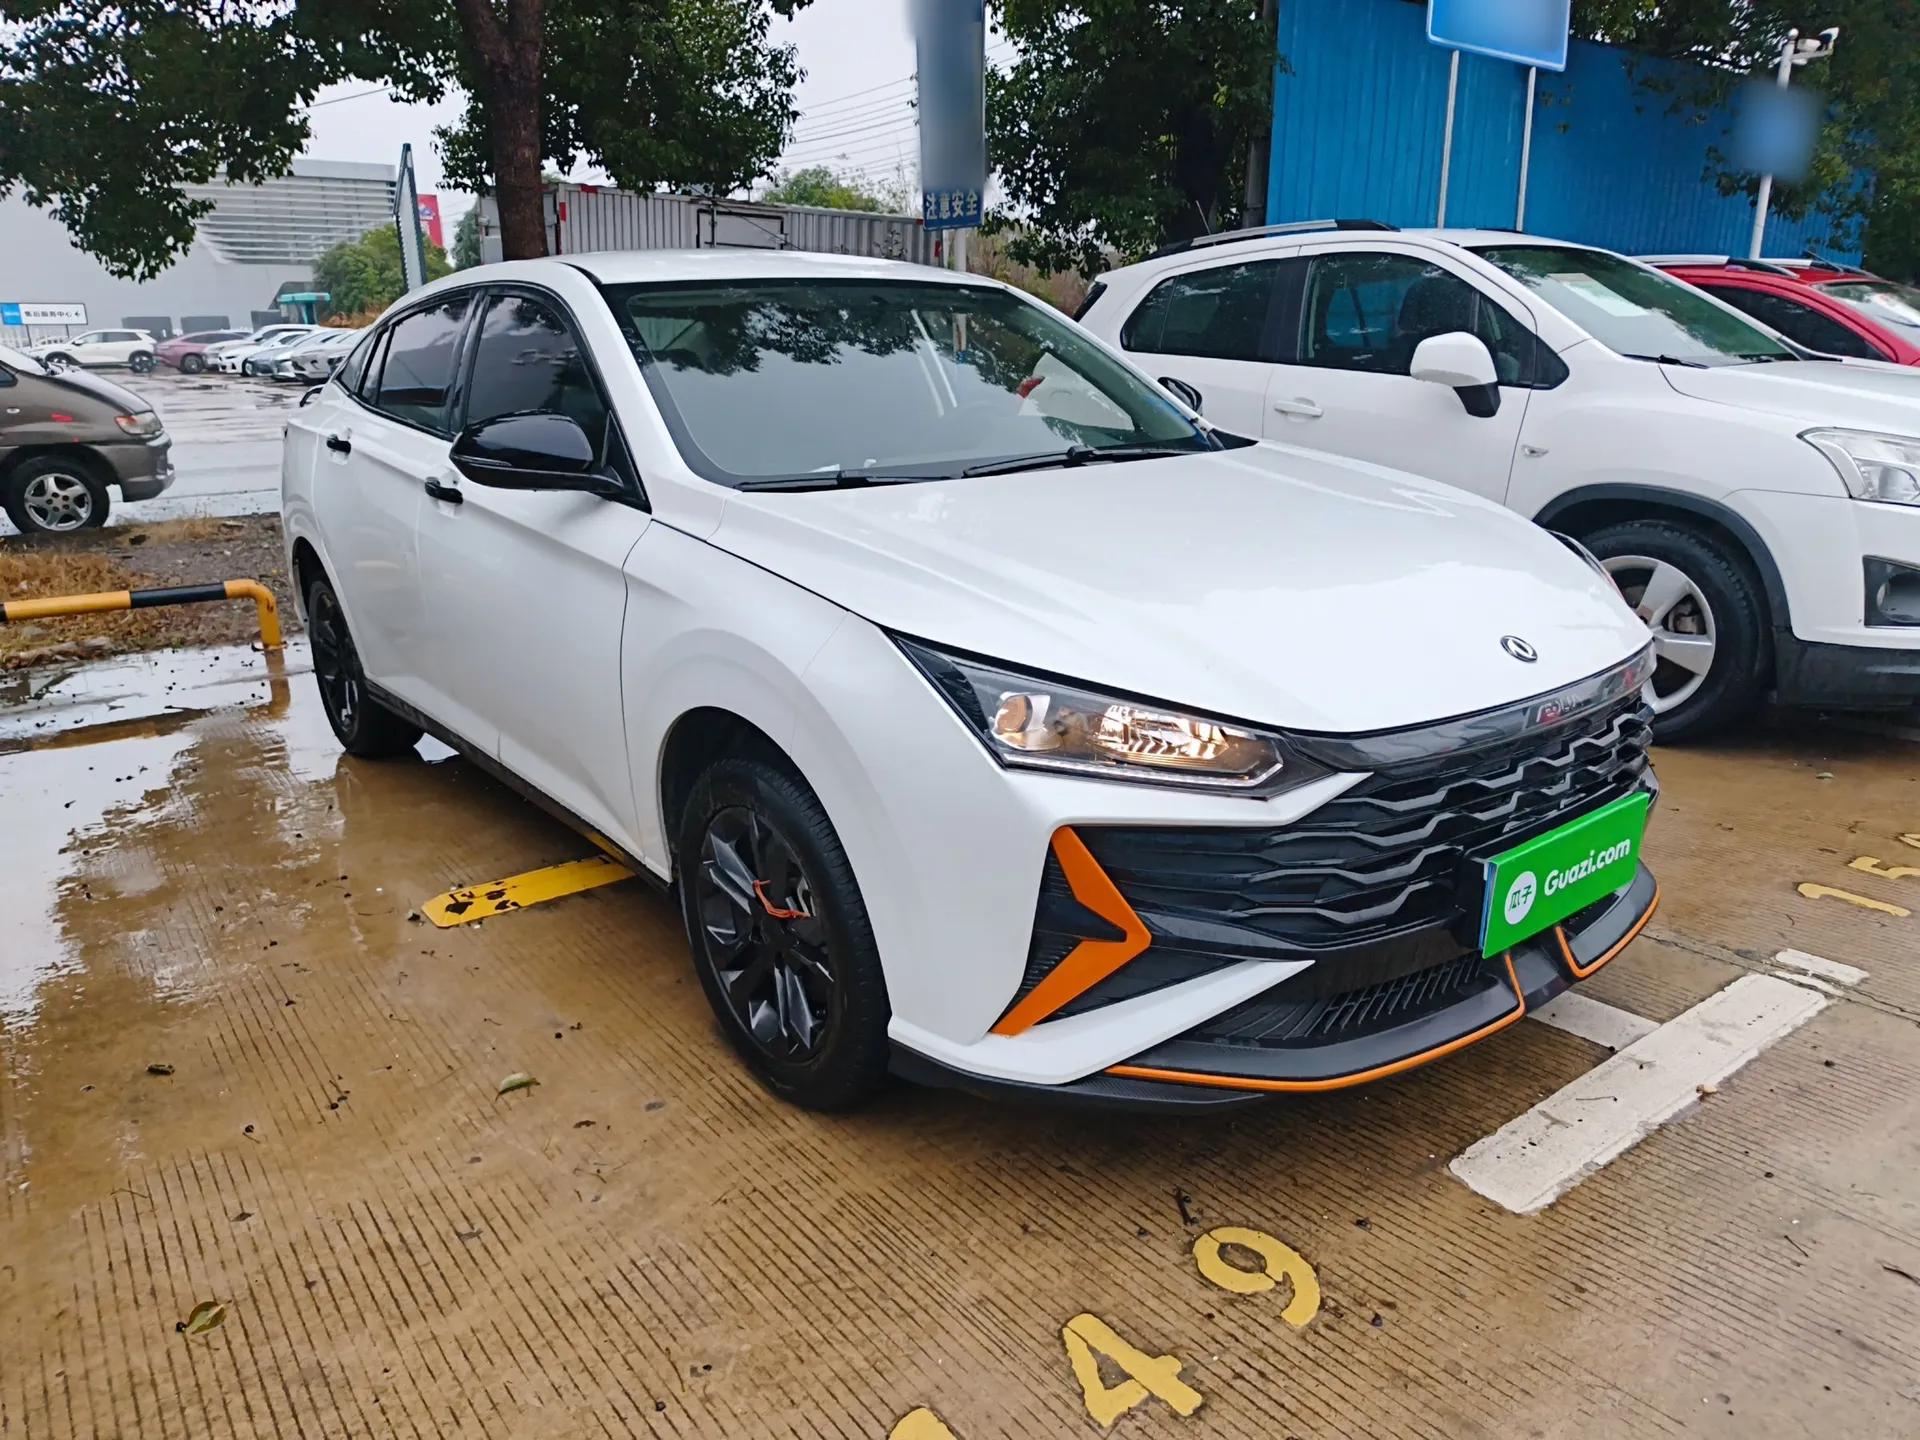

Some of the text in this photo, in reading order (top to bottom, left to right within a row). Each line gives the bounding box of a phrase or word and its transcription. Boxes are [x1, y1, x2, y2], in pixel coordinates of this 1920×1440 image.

[926, 189, 978, 220] 注意安全
[1544, 838, 1632, 896] Guazi.com
[1509, 884, 1533, 911] 瓜子
[889, 1226, 1321, 1440] 49
